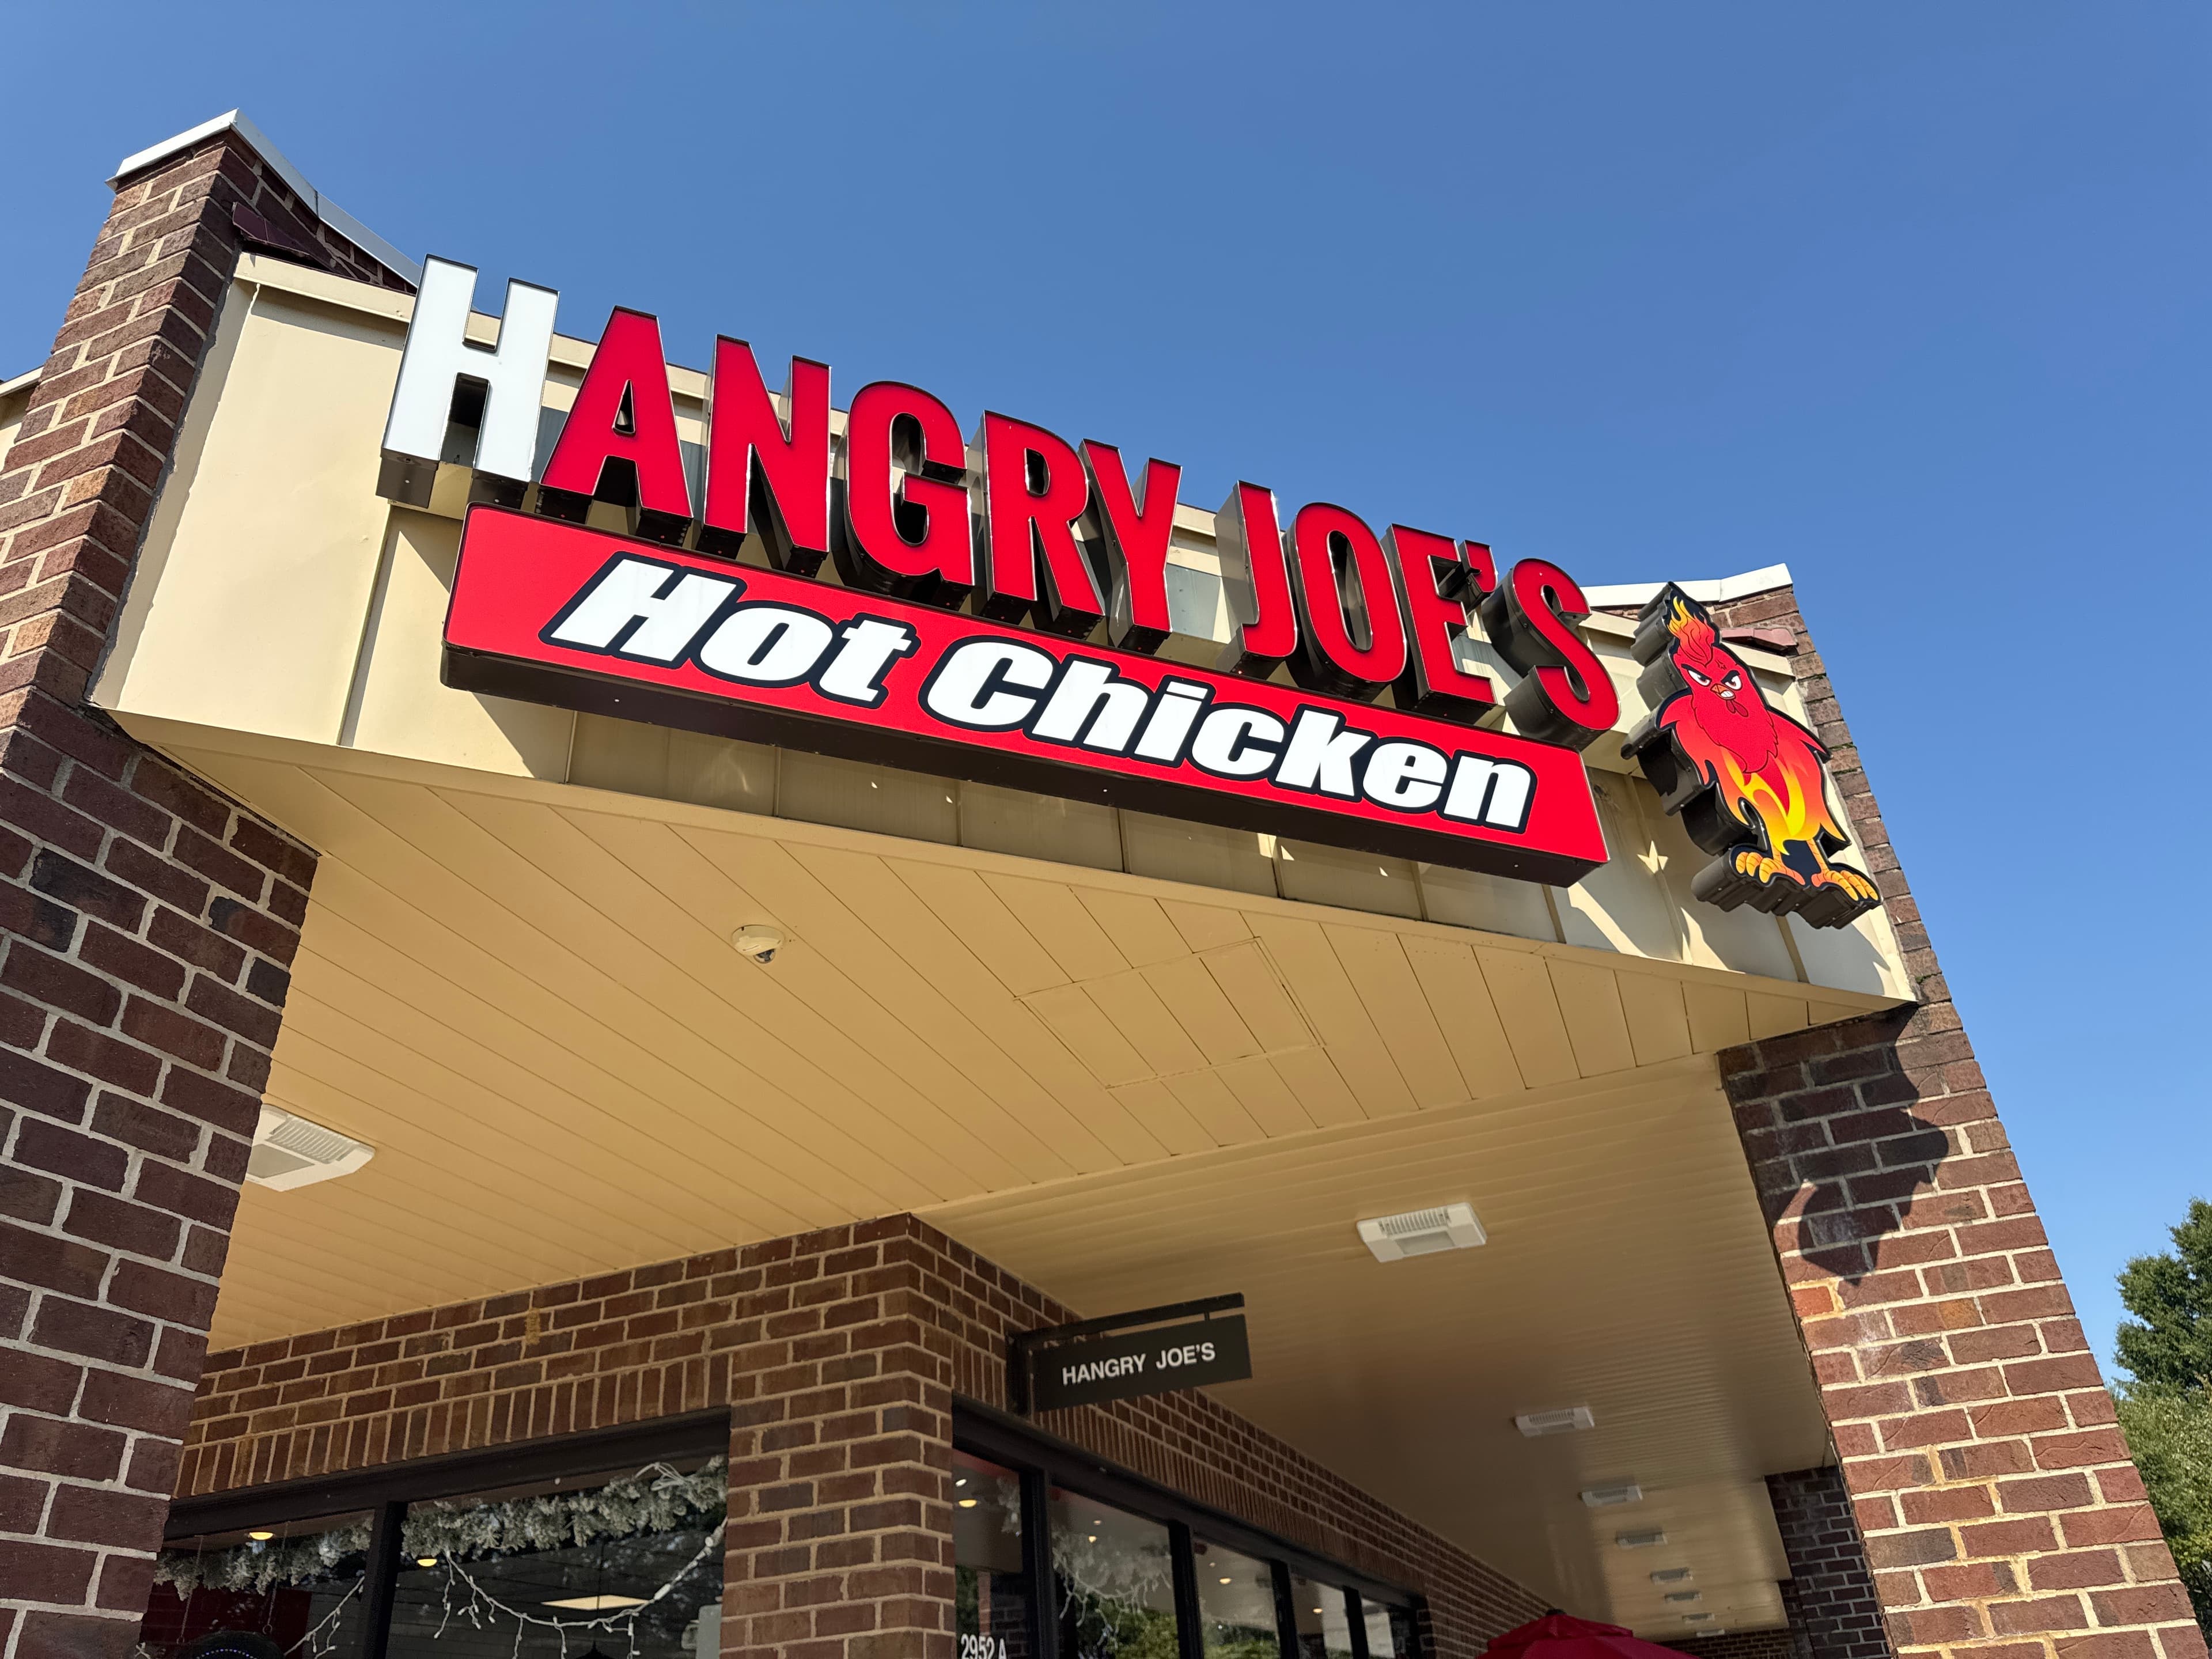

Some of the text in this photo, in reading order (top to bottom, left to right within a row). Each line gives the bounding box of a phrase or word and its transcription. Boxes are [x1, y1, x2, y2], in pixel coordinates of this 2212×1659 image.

[382, 254, 1619, 732] HANGRY JOE'S
[544, 555, 1532, 830] Hot Chicken
[1062, 1342, 1215, 1385] HANGRY JOE'S
[960, 1633, 995, 1659] 2952
